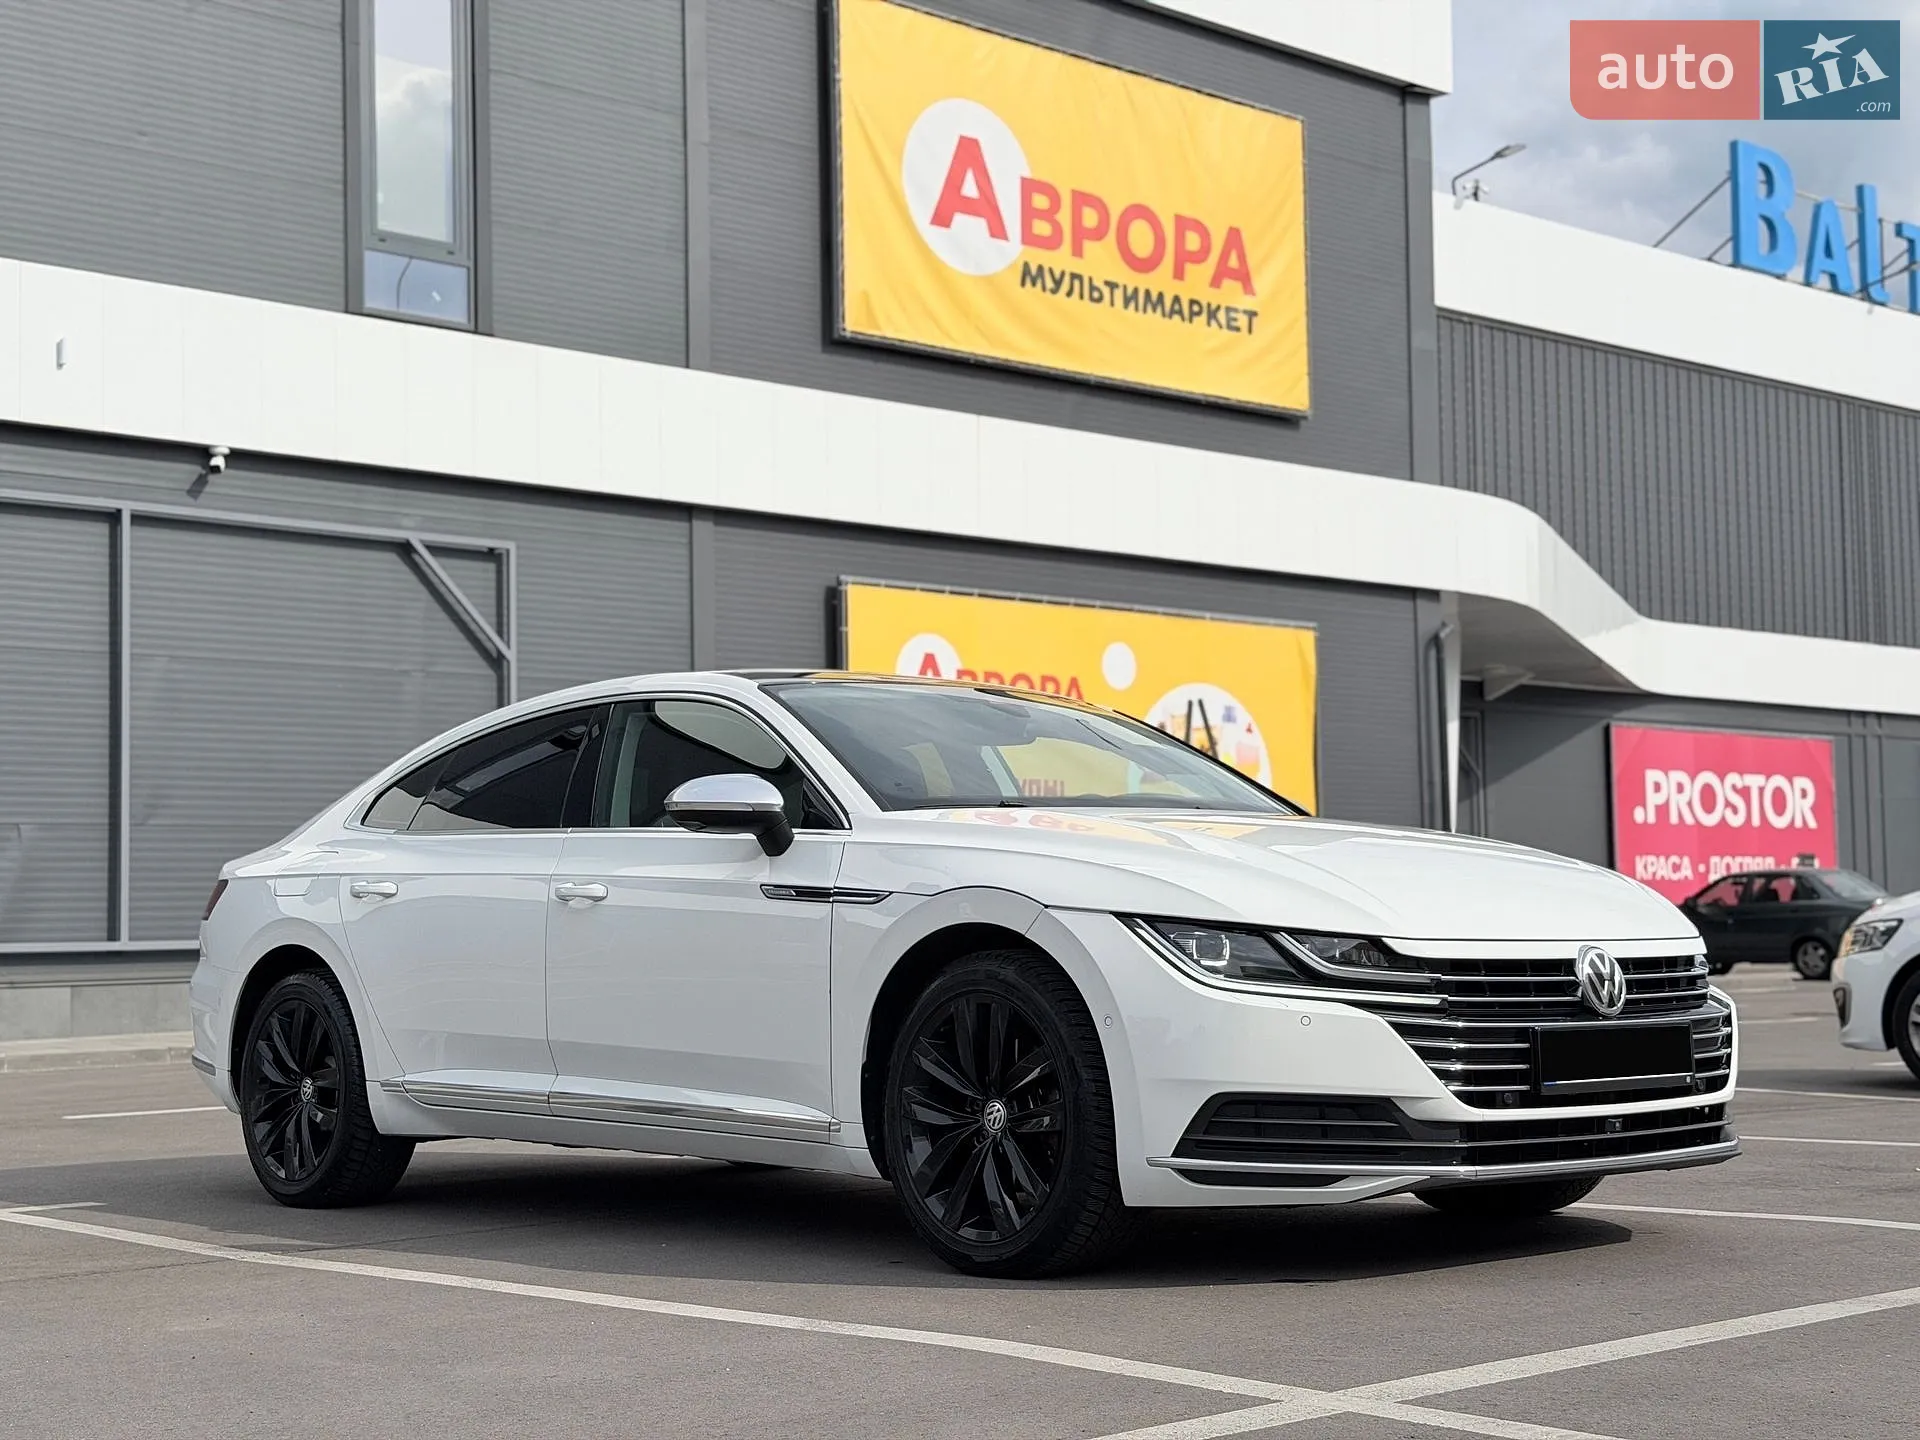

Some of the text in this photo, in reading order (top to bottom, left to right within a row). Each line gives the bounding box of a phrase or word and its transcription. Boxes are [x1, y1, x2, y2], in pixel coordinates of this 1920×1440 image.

[929, 134, 1257, 297] АВРОРА
[1019, 261, 1259, 335] МУЛЬТИМАРКЕТ
[1634, 855, 1694, 880] КРАСА
